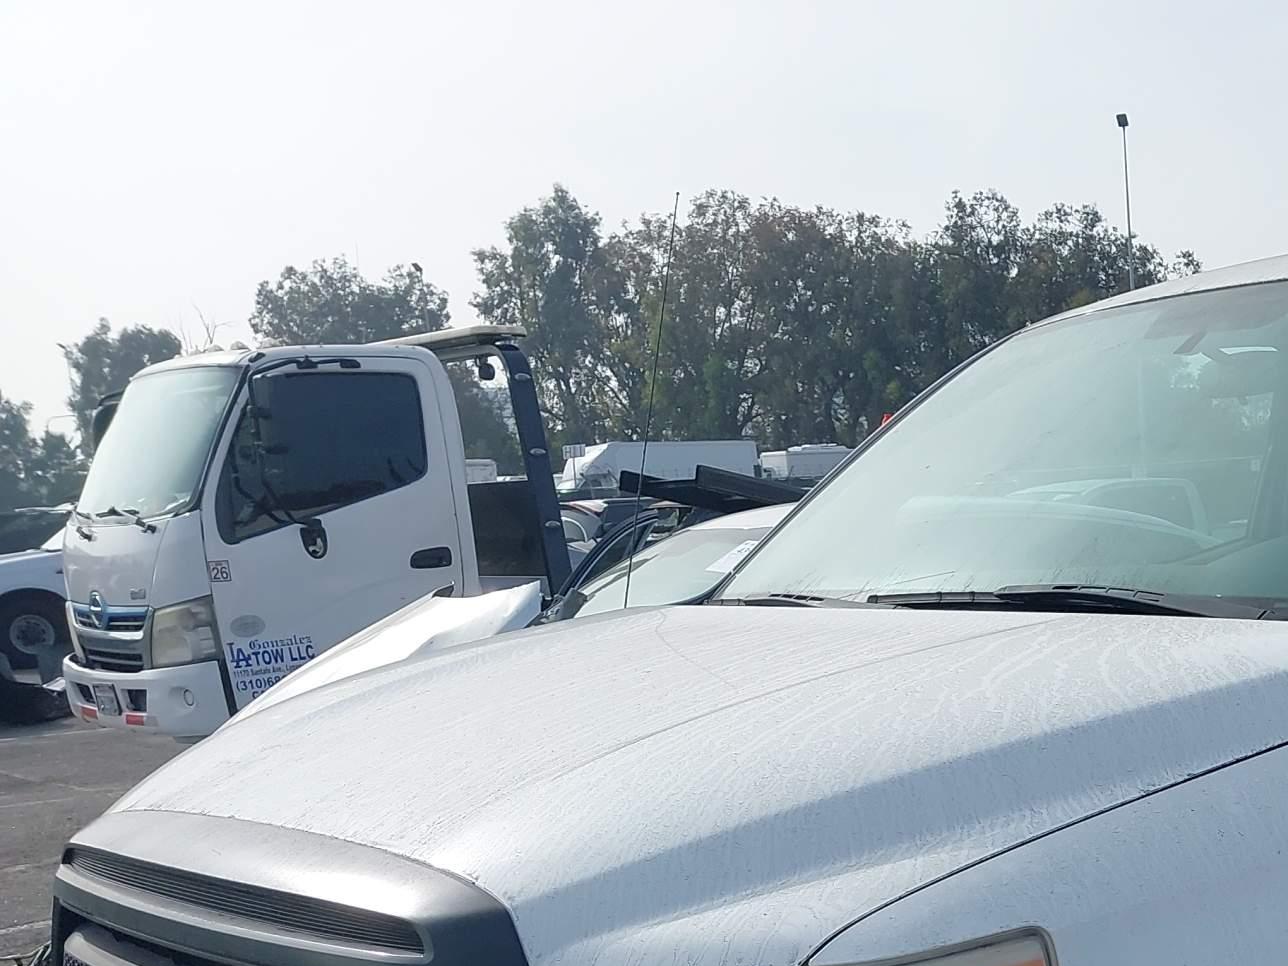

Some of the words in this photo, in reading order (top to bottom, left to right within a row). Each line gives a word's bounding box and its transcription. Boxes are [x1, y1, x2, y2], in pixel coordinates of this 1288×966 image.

[211, 566, 229, 580] 26
[249, 635, 312, 650] Gonzalez
[226, 642, 252, 668] LA
[251, 648, 285, 666] TOW
[288, 644, 316, 662] LLC
